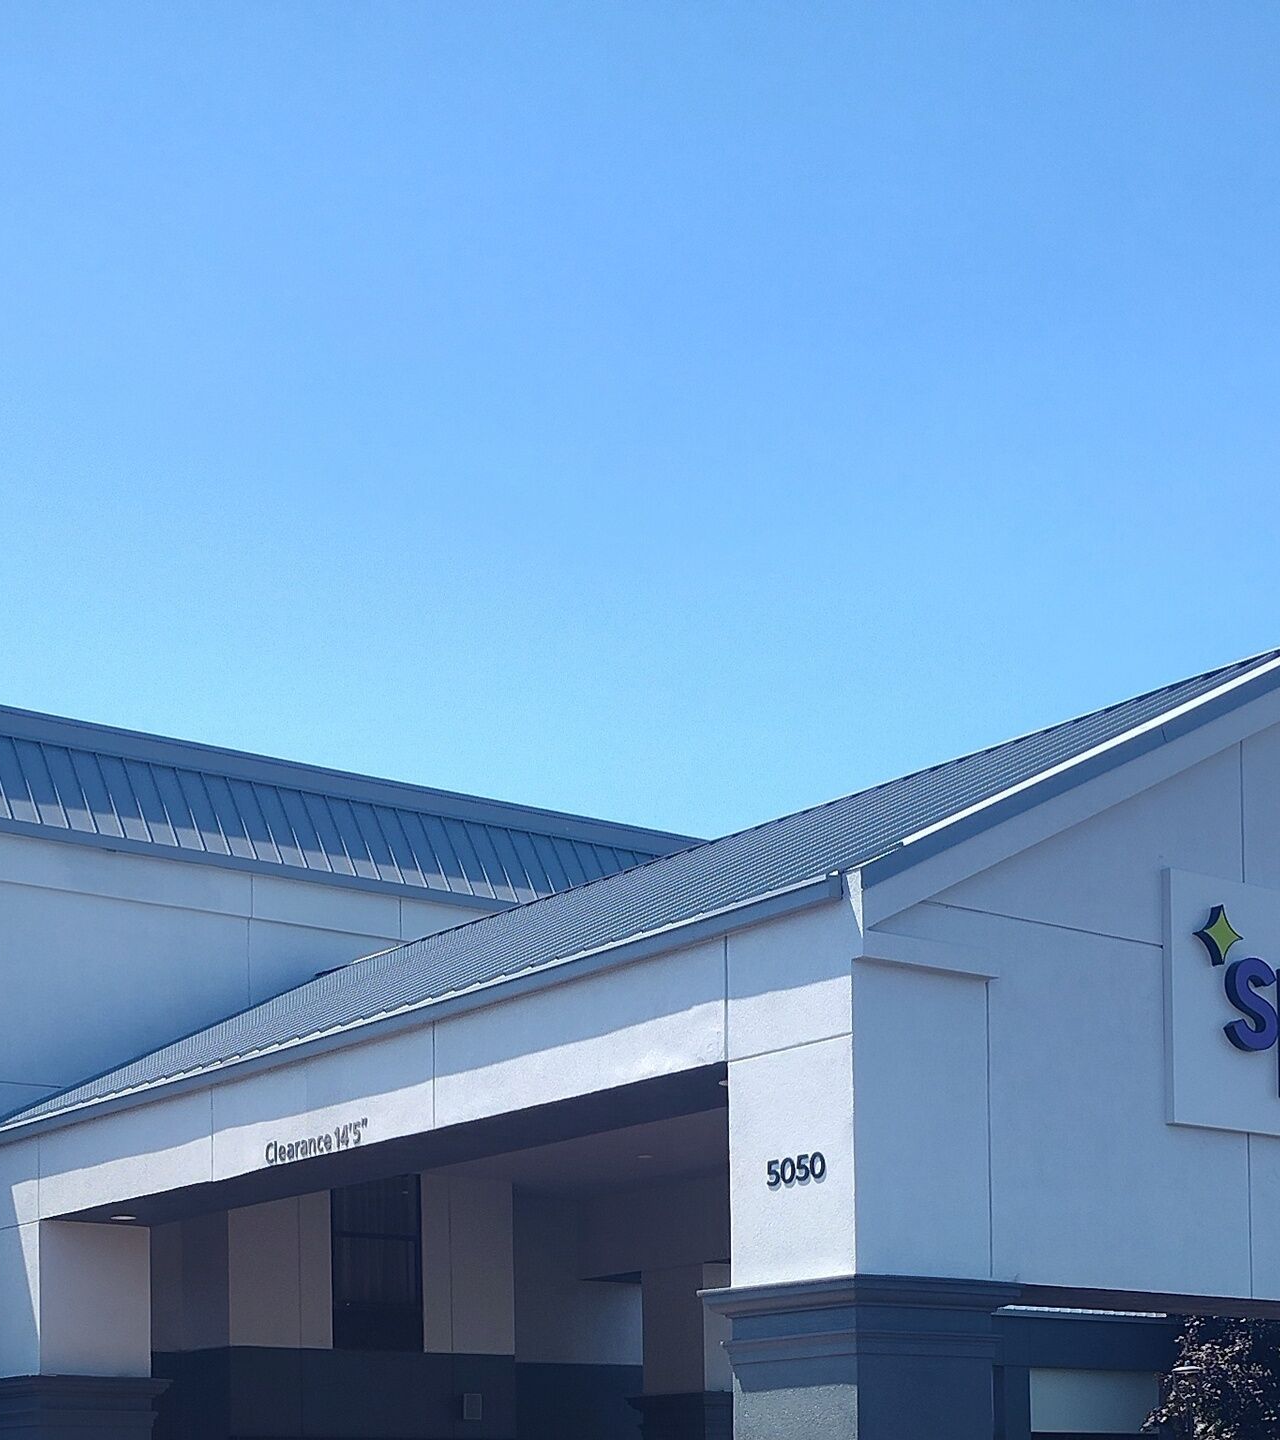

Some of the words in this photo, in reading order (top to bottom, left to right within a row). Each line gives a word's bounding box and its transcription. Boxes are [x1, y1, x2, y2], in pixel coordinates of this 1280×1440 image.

[265, 1133, 332, 1164] Clearance
[334, 1117, 368, 1150] 14'5"
[766, 1151, 826, 1187] 5050
